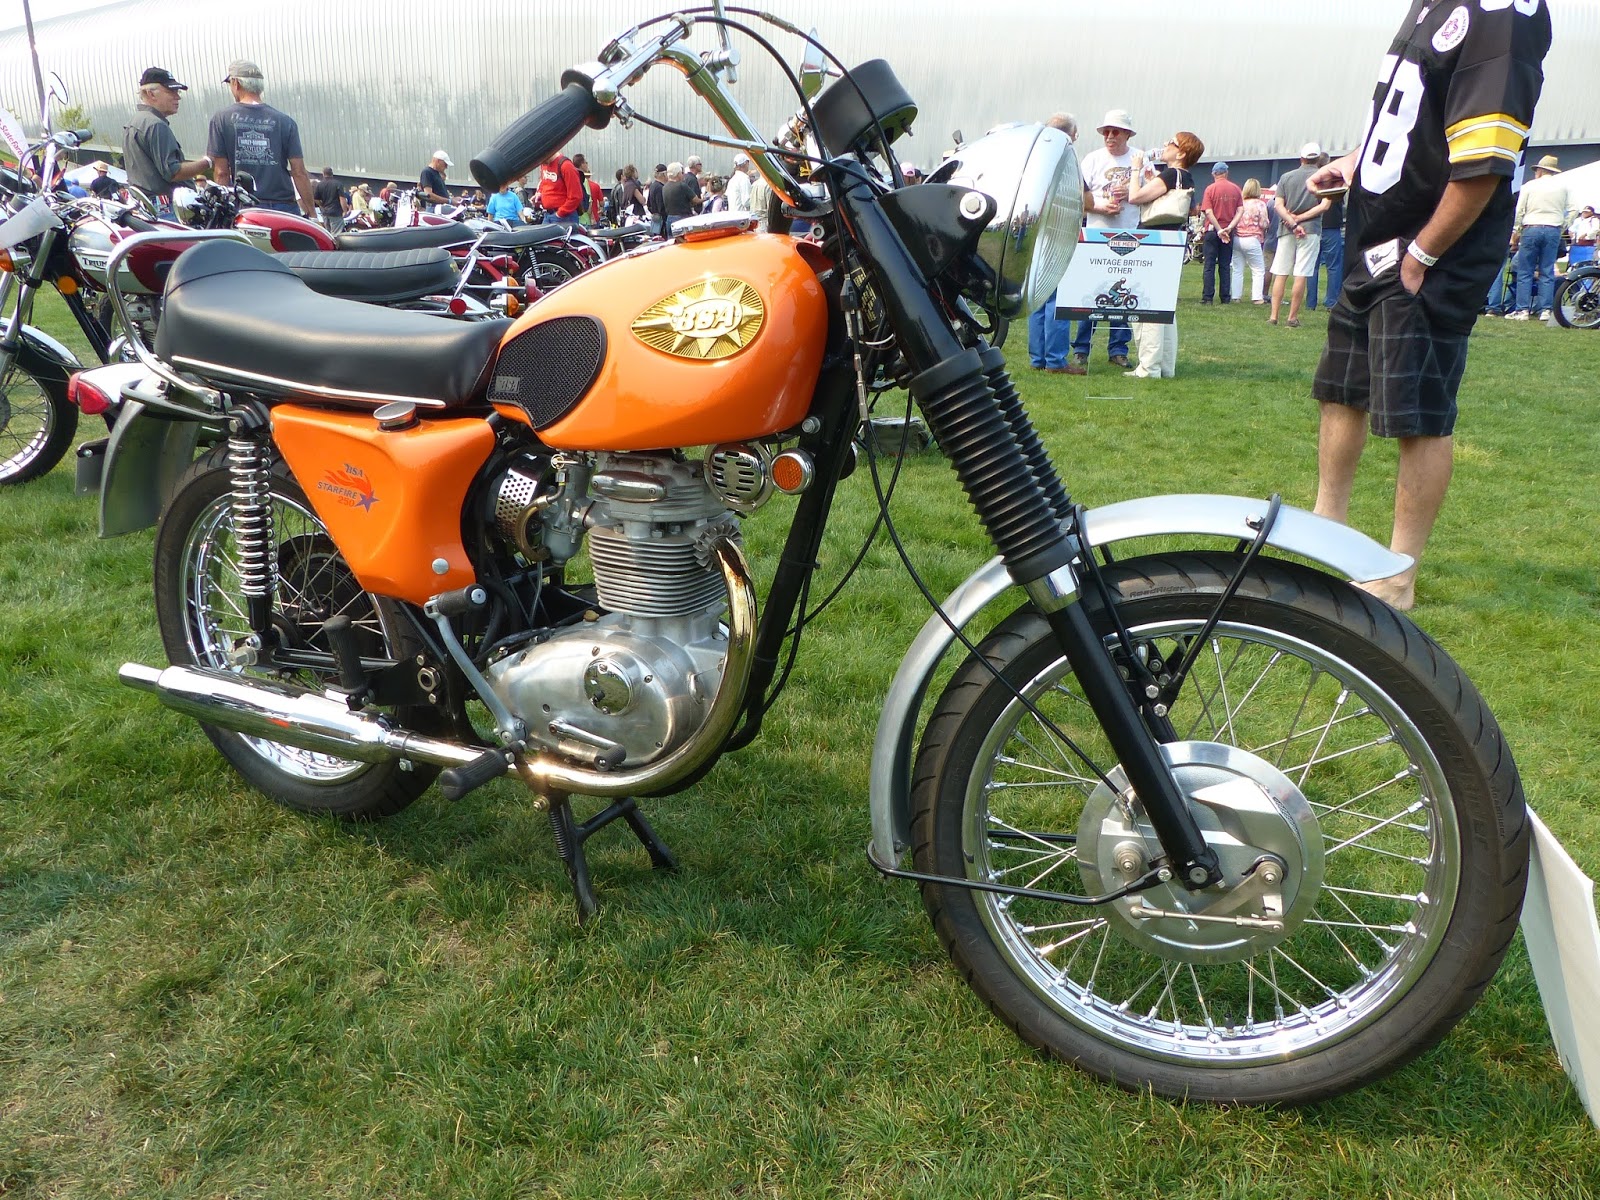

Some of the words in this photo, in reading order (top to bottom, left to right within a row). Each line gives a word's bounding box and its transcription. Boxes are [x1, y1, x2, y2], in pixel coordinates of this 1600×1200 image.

[82, 257, 109, 270] TRIUM
[1090, 258, 1121, 266] VINTAGE
[1123, 259, 1153, 267] BRITISH
[676, 304, 736, 331] BSA
[344, 463, 363, 477] BSA
[317, 481, 358, 499] STARFIRE
[338, 495, 355, 507] 250
